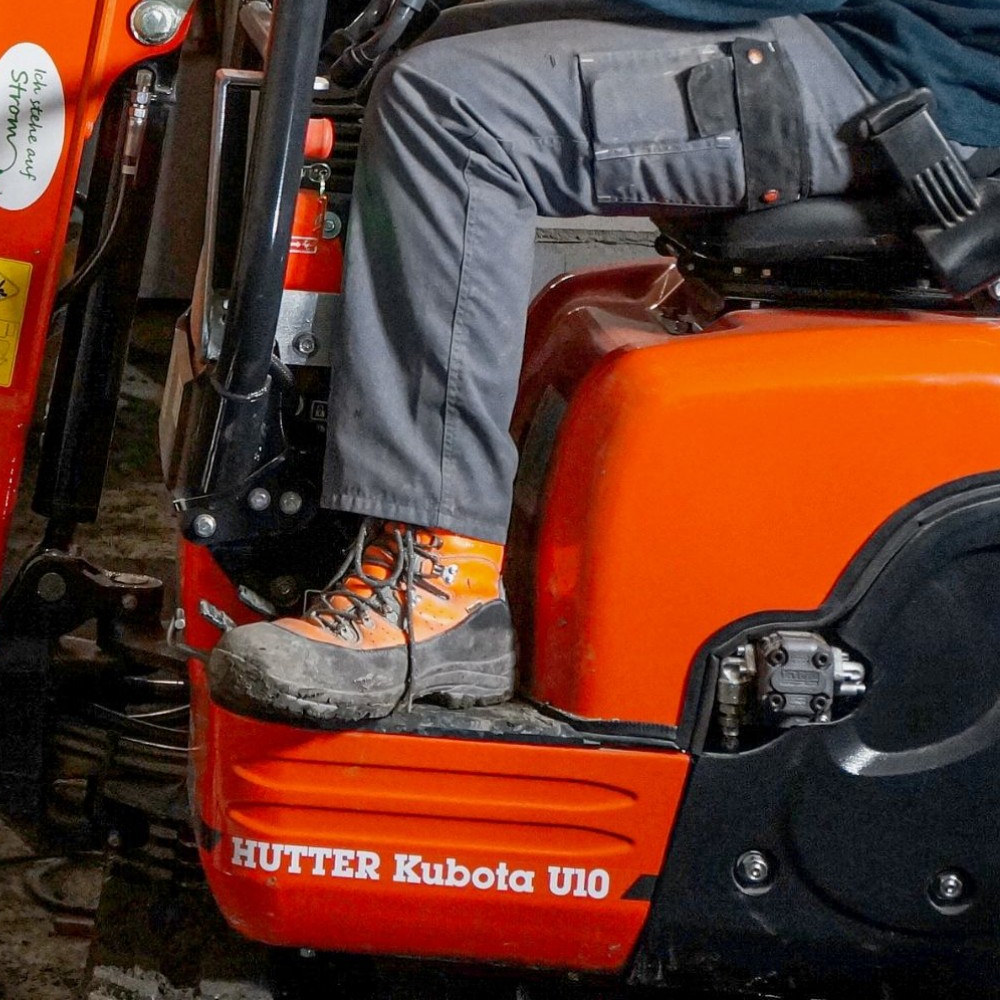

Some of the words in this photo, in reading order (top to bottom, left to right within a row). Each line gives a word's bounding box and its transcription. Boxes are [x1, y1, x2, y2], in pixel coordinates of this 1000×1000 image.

[33, 68, 47, 94] Ich
[6, 69, 29, 141] Strom
[28, 98, 43, 143] stehe
[19, 148, 37, 181] auf
[231, 837, 380, 880] HUTTER
[393, 853, 535, 893] Kubota
[548, 866, 611, 899] U10
